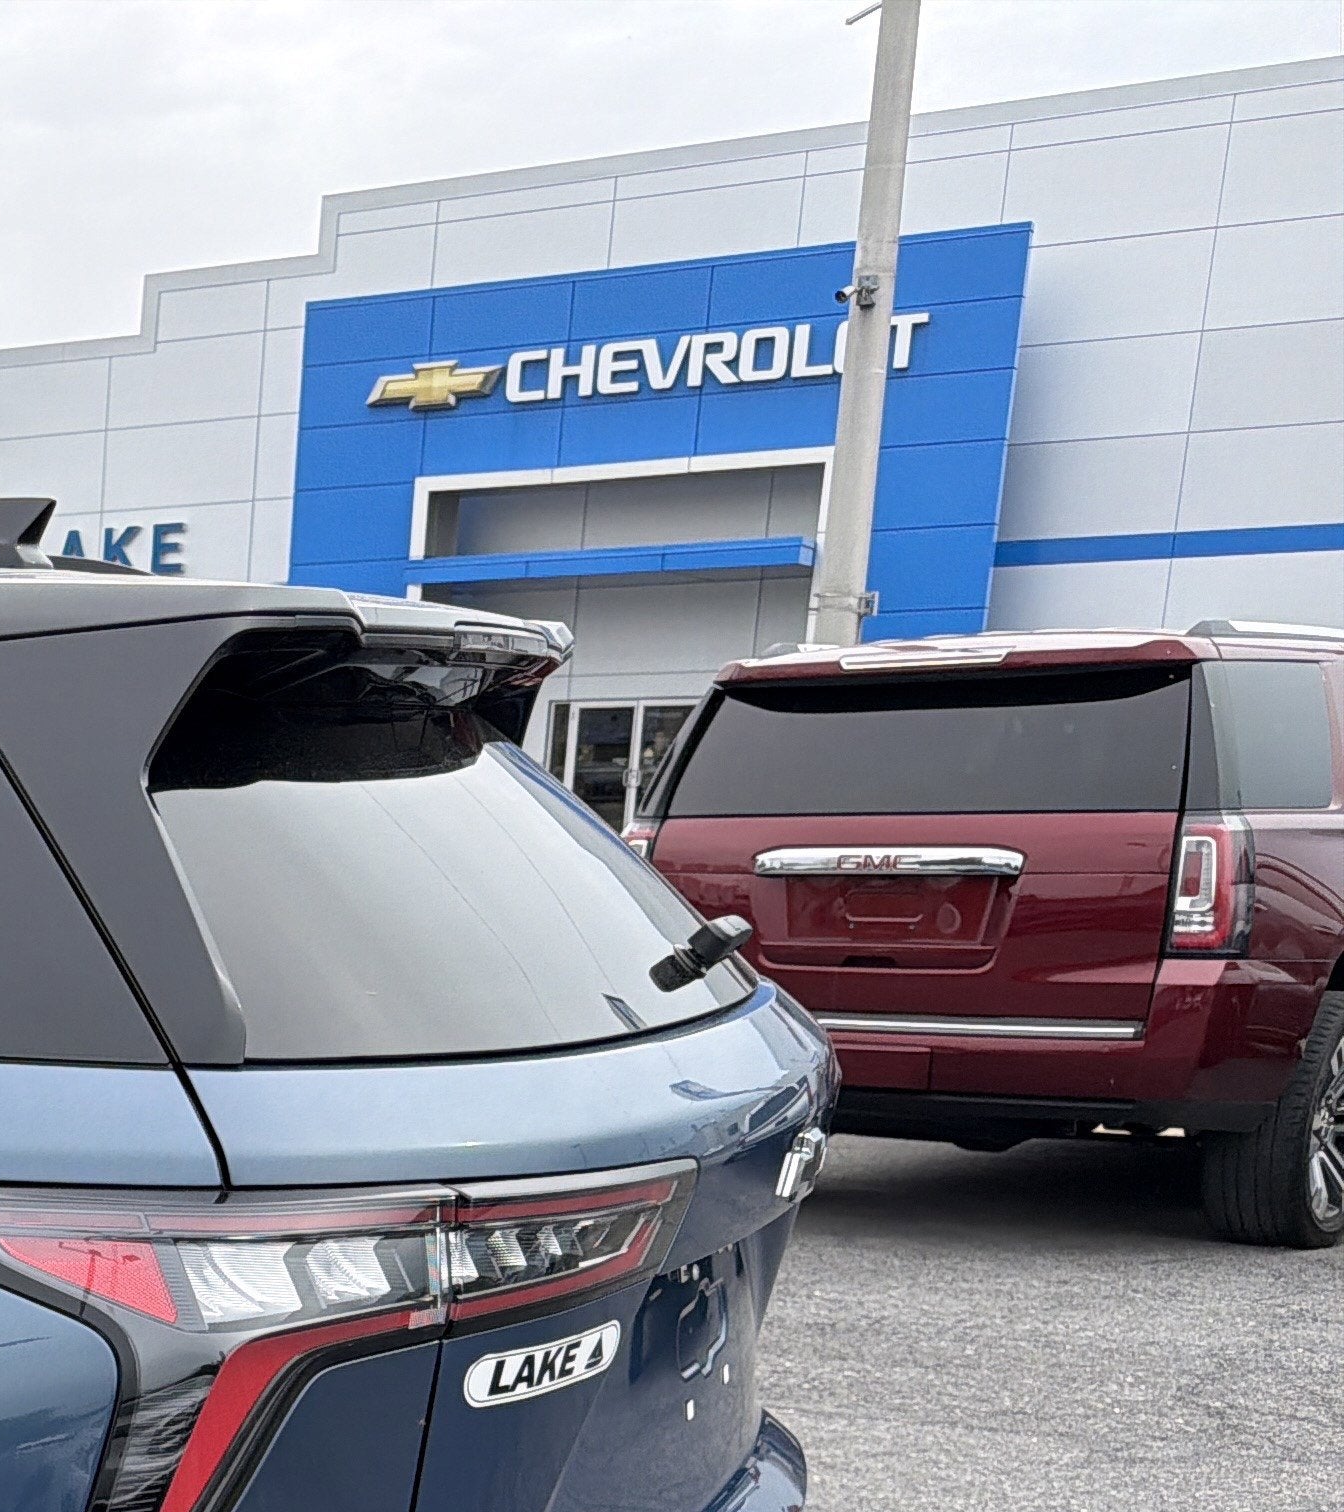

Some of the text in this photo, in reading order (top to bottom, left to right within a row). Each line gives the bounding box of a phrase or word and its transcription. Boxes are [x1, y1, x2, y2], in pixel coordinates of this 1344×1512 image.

[505, 312, 931, 404] CHEVROLT
[61, 522, 187, 575] AKE
[836, 854, 923, 872] GMC
[487, 1340, 582, 1397] LAKE
